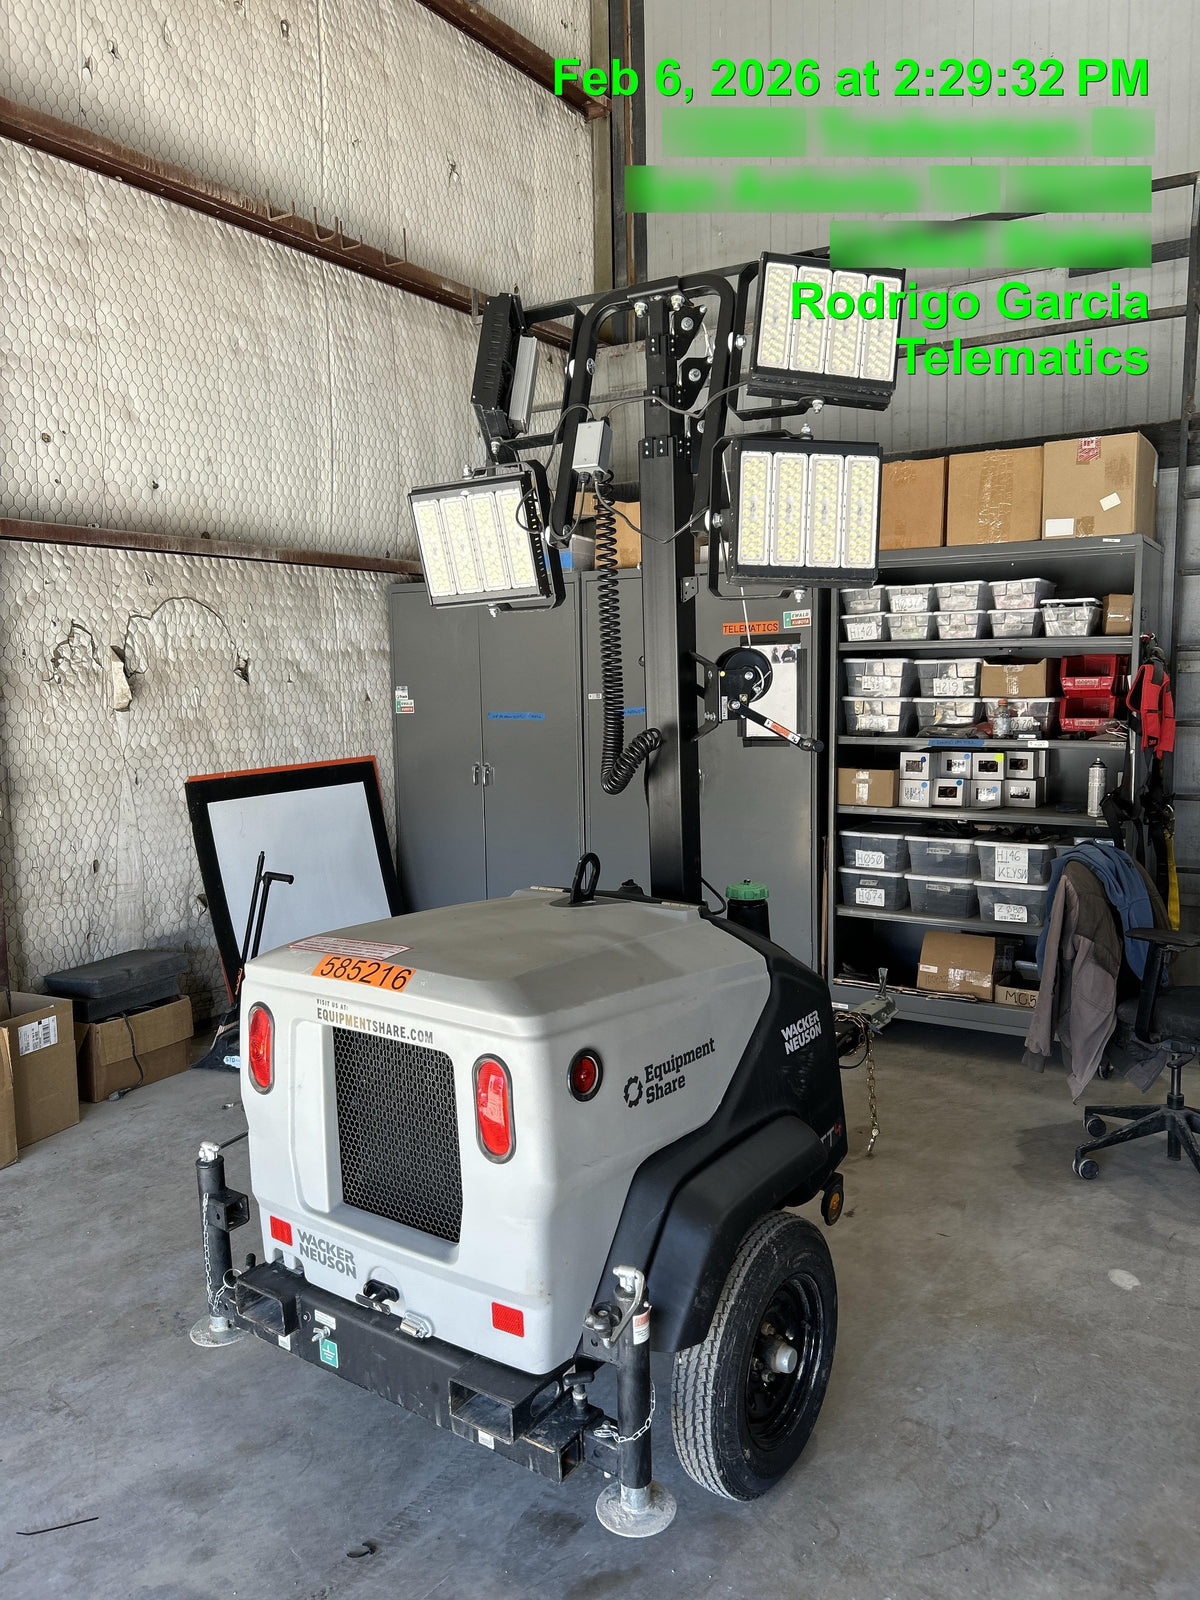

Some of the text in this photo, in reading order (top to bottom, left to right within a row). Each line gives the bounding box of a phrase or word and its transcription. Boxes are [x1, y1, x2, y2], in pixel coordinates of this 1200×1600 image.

[723, 623, 778, 633] TELEMATICS
[320, 956, 412, 990] 585216
[316, 999, 330, 1007] VISIT
[317, 1007, 434, 1044] EQUIPMENTSHARE.COM
[781, 1010, 820, 1040] WACKER
[784, 1022, 822, 1055] NEUSON
[644, 1037, 716, 1084] Equipment
[645, 1075, 686, 1104] Share
[297, 1228, 356, 1266] WACKER
[299, 1242, 358, 1280] NEUSON
